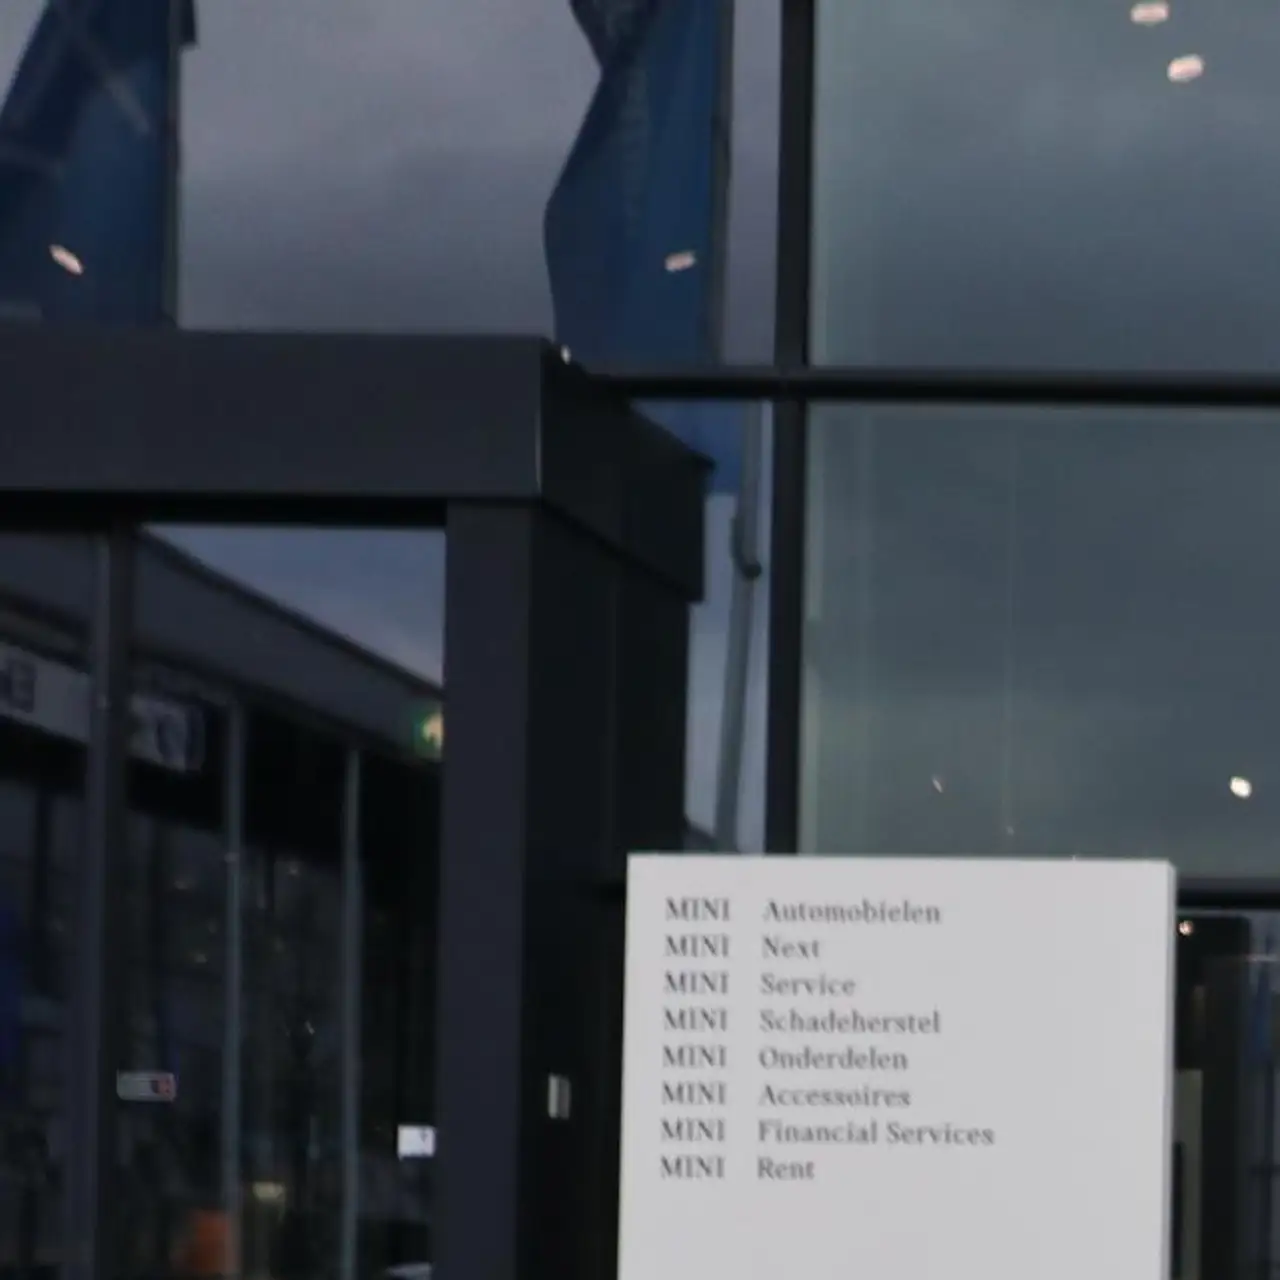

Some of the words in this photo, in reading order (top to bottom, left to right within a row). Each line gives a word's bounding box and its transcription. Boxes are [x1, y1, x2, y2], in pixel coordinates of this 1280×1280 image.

[666, 897, 729, 922] MINI
[763, 899, 941, 924] Automobielen
[665, 934, 729, 958] MINI
[762, 935, 820, 959] Next
[664, 971, 728, 995] MINI
[761, 973, 856, 996] Service
[664, 1007, 727, 1031] MINI
[760, 1009, 940, 1034] Schadeherstel
[663, 1044, 726, 1068] MINI
[758, 1046, 908, 1070] Onderdelen
[662, 1081, 726, 1105] MINI
[759, 1084, 911, 1107] Accessoires
[661, 1118, 725, 1142] MINI
[758, 1119, 878, 1144] Financial
[886, 1121, 995, 1146] Services
[660, 1155, 725, 1179] MINI
[757, 1156, 815, 1180] Rent
